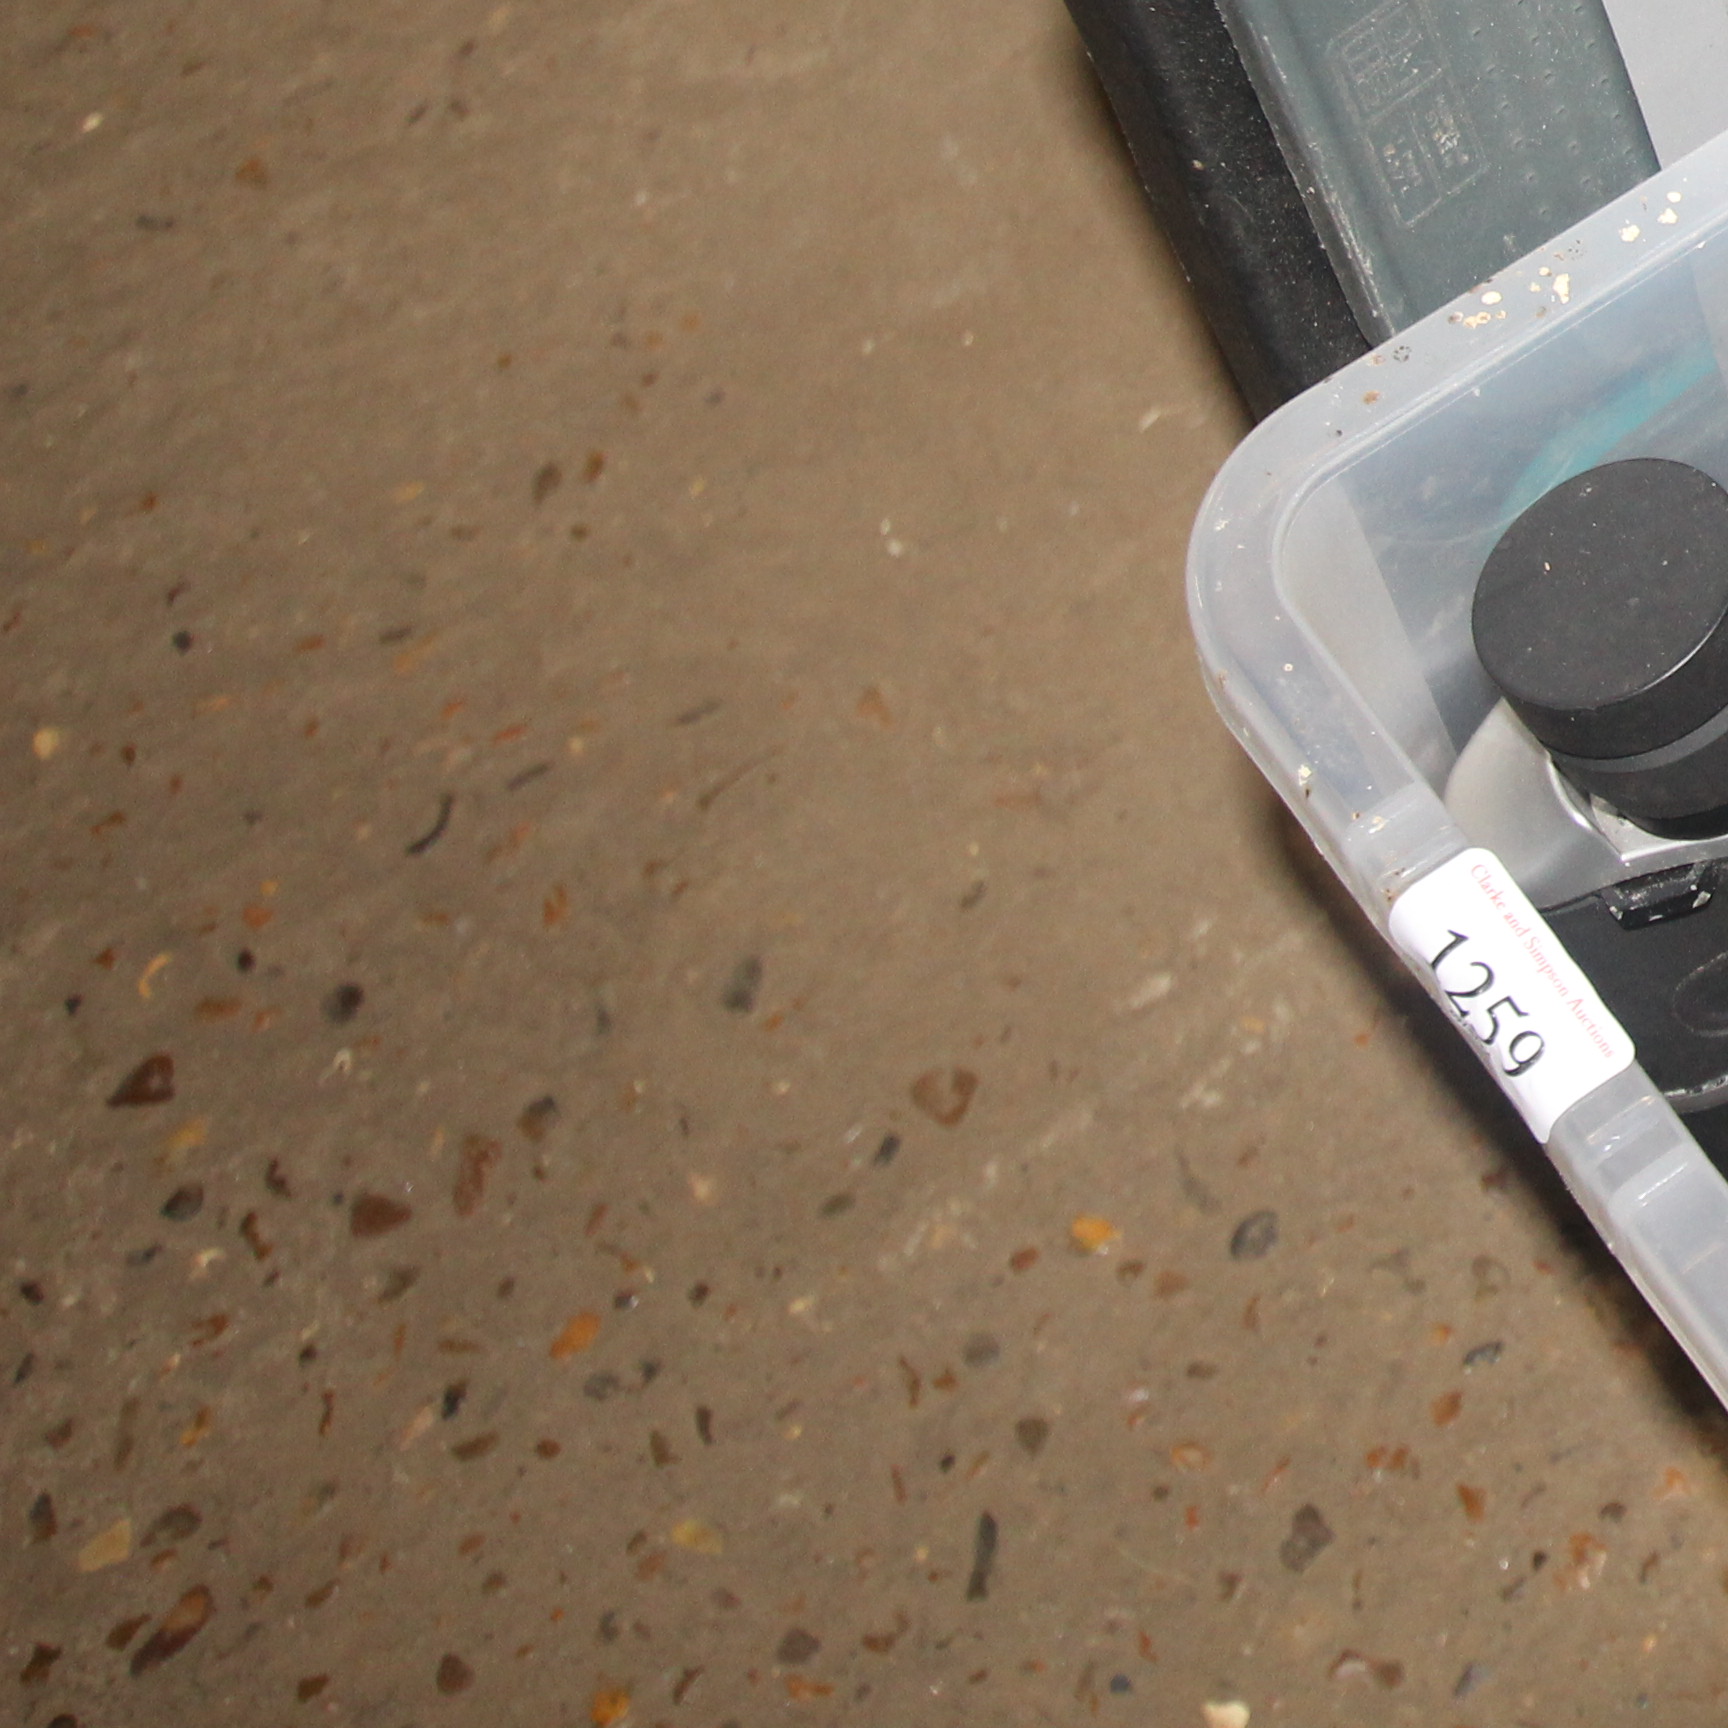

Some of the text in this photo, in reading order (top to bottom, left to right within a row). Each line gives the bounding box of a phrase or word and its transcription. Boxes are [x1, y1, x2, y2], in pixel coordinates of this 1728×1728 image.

[1430, 928, 1545, 1077] 1259
[1470, 863, 1614, 1059] Clarke and Simpson Auctions
